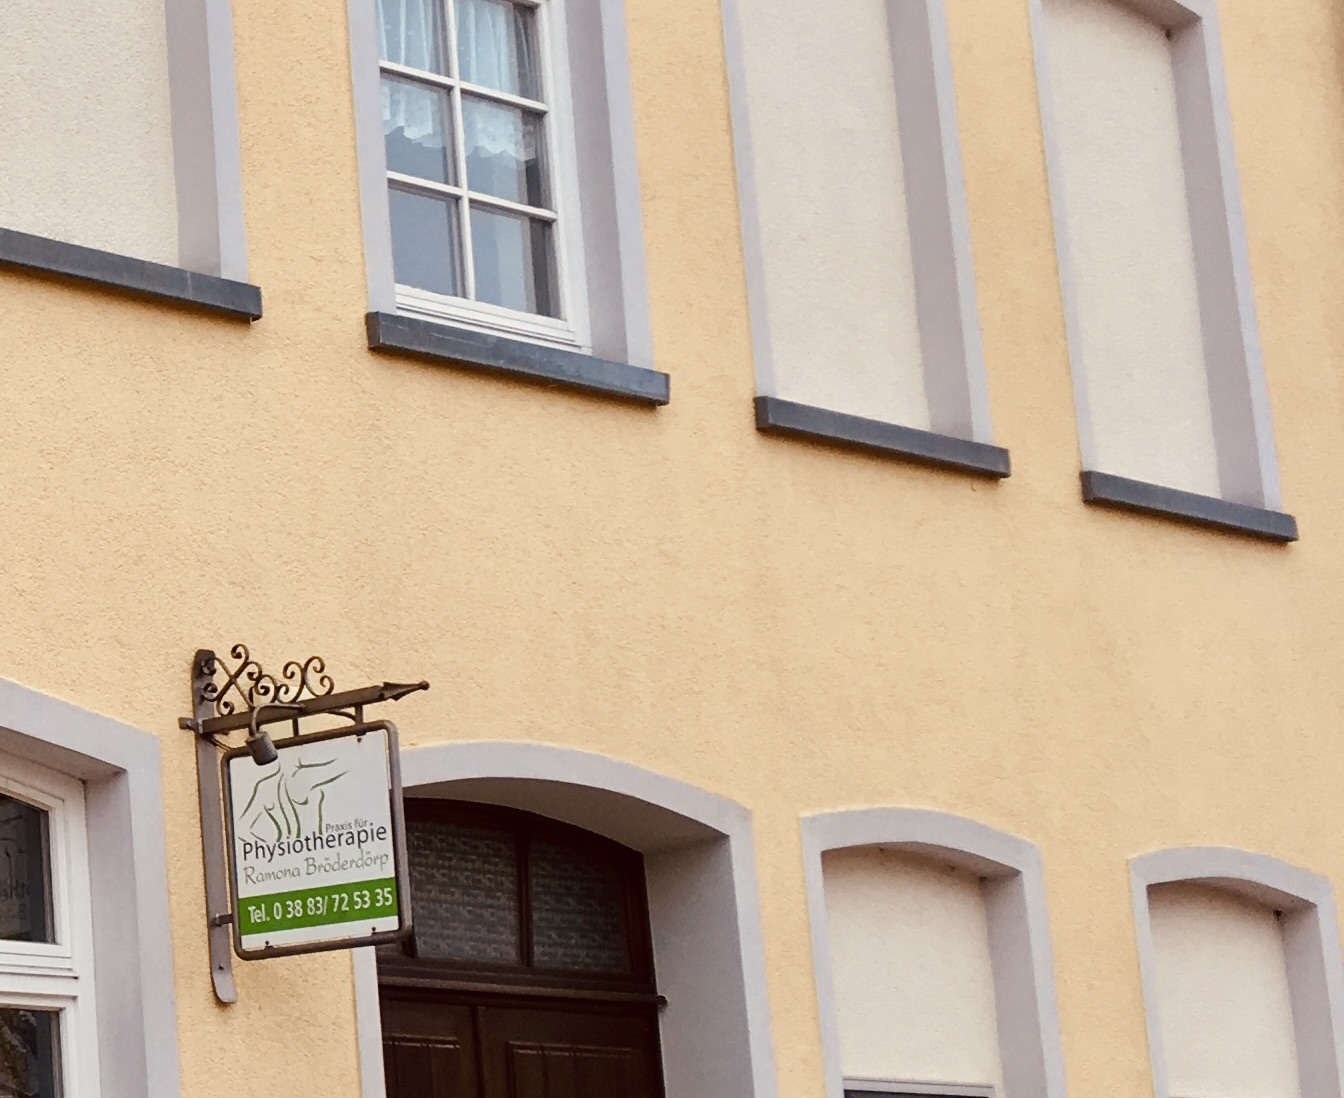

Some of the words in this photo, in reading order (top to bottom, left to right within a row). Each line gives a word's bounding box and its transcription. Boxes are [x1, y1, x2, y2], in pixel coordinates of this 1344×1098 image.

[325, 820, 353, 833] Praxis
[354, 817, 368, 829] für
[242, 822, 388, 863] Physiotherapie
[243, 865, 301, 885] Ramona
[247, 903, 271, 924] Tel.
[273, 902, 283, 920] 0
[286, 899, 303, 919] 38
[331, 893, 350, 913] 72
[353, 889, 371, 910] 53
[375, 887, 393, 907] 35
